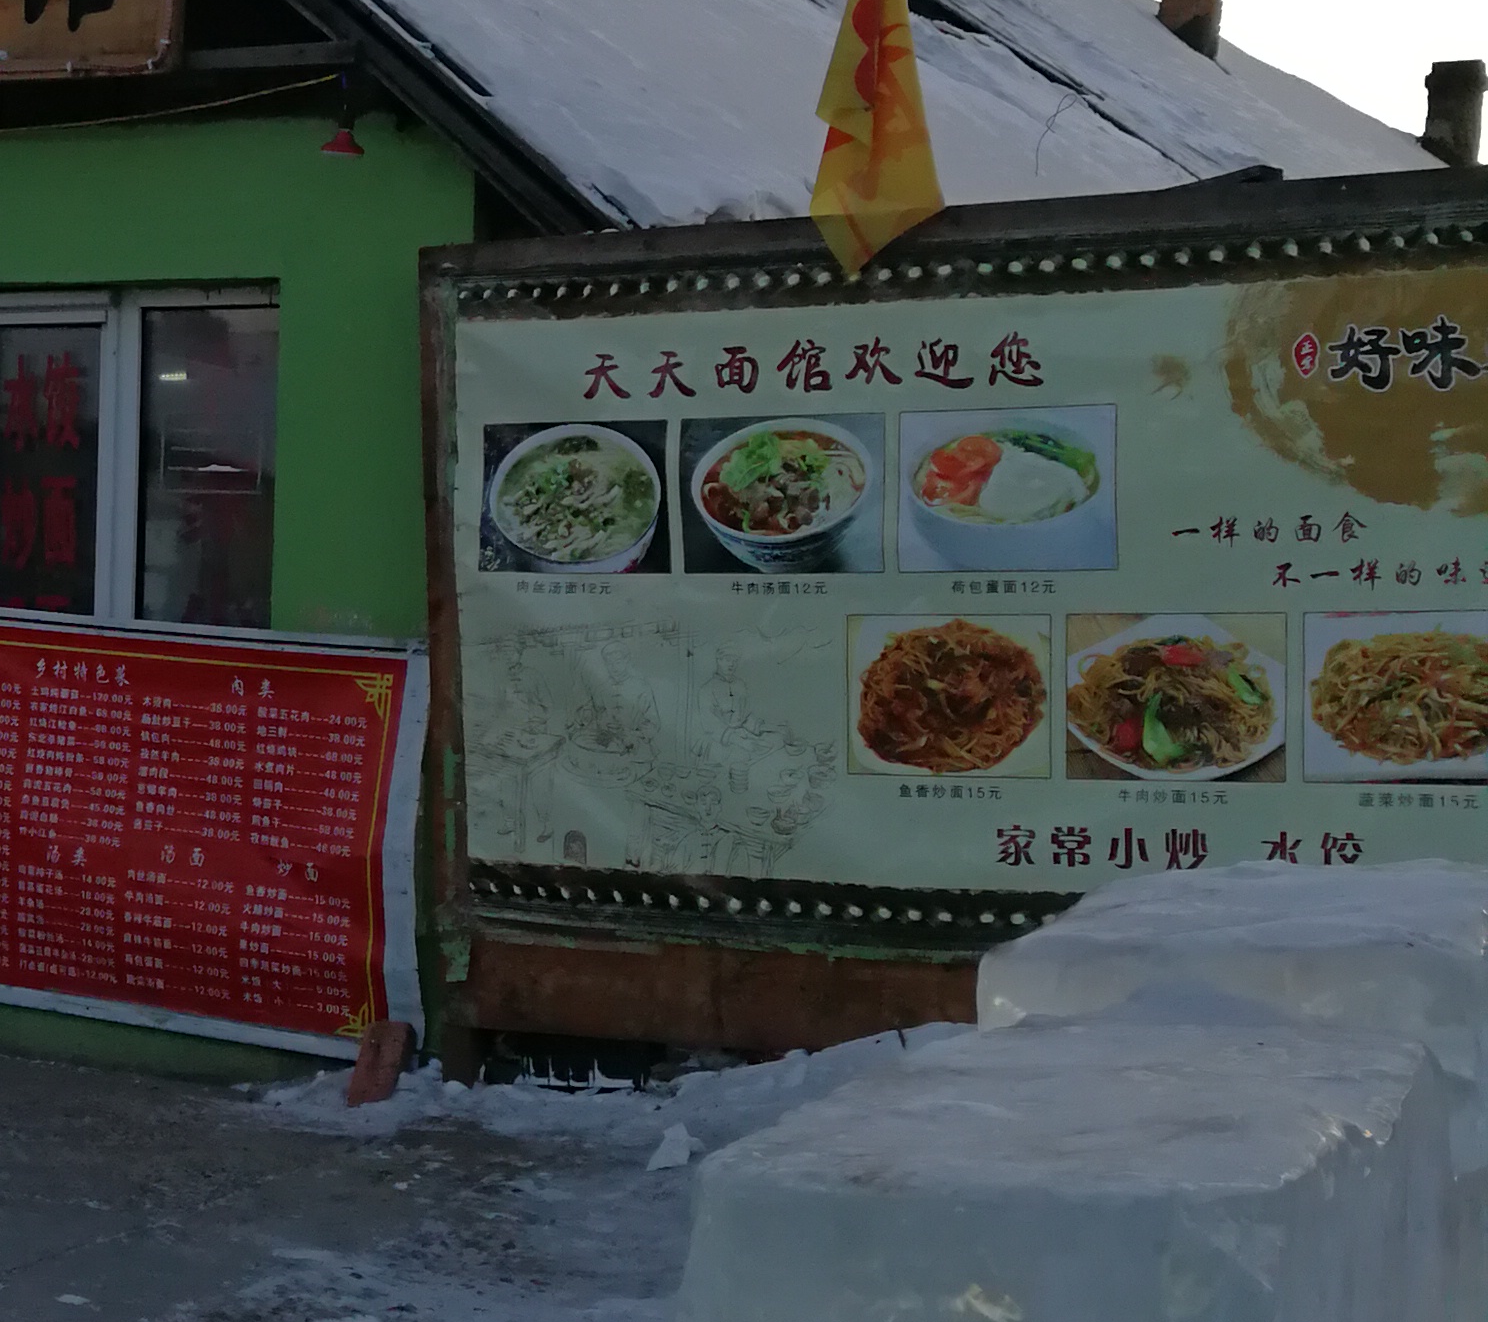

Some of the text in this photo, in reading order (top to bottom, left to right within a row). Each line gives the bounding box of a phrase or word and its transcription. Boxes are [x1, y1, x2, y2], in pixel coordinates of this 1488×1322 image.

[1326, 314, 1488, 393] 好味
[582, 331, 1044, 401] 天天面馆欢迎您
[1171, 511, 1367, 548] 一样的面食
[516, 579, 612, 596] 肉丝汤面12元
[731, 579, 828, 597] 牛肉汤面12元
[950, 579, 1056, 596] 荷包蛋面12元
[36, 658, 130, 687] 乡村特色菜
[897, 782, 1003, 802] 鱼香炒面15元
[1116, 789, 1229, 808] 牛肉炒面15元
[995, 825, 1366, 871] 家常小炒 水饺
